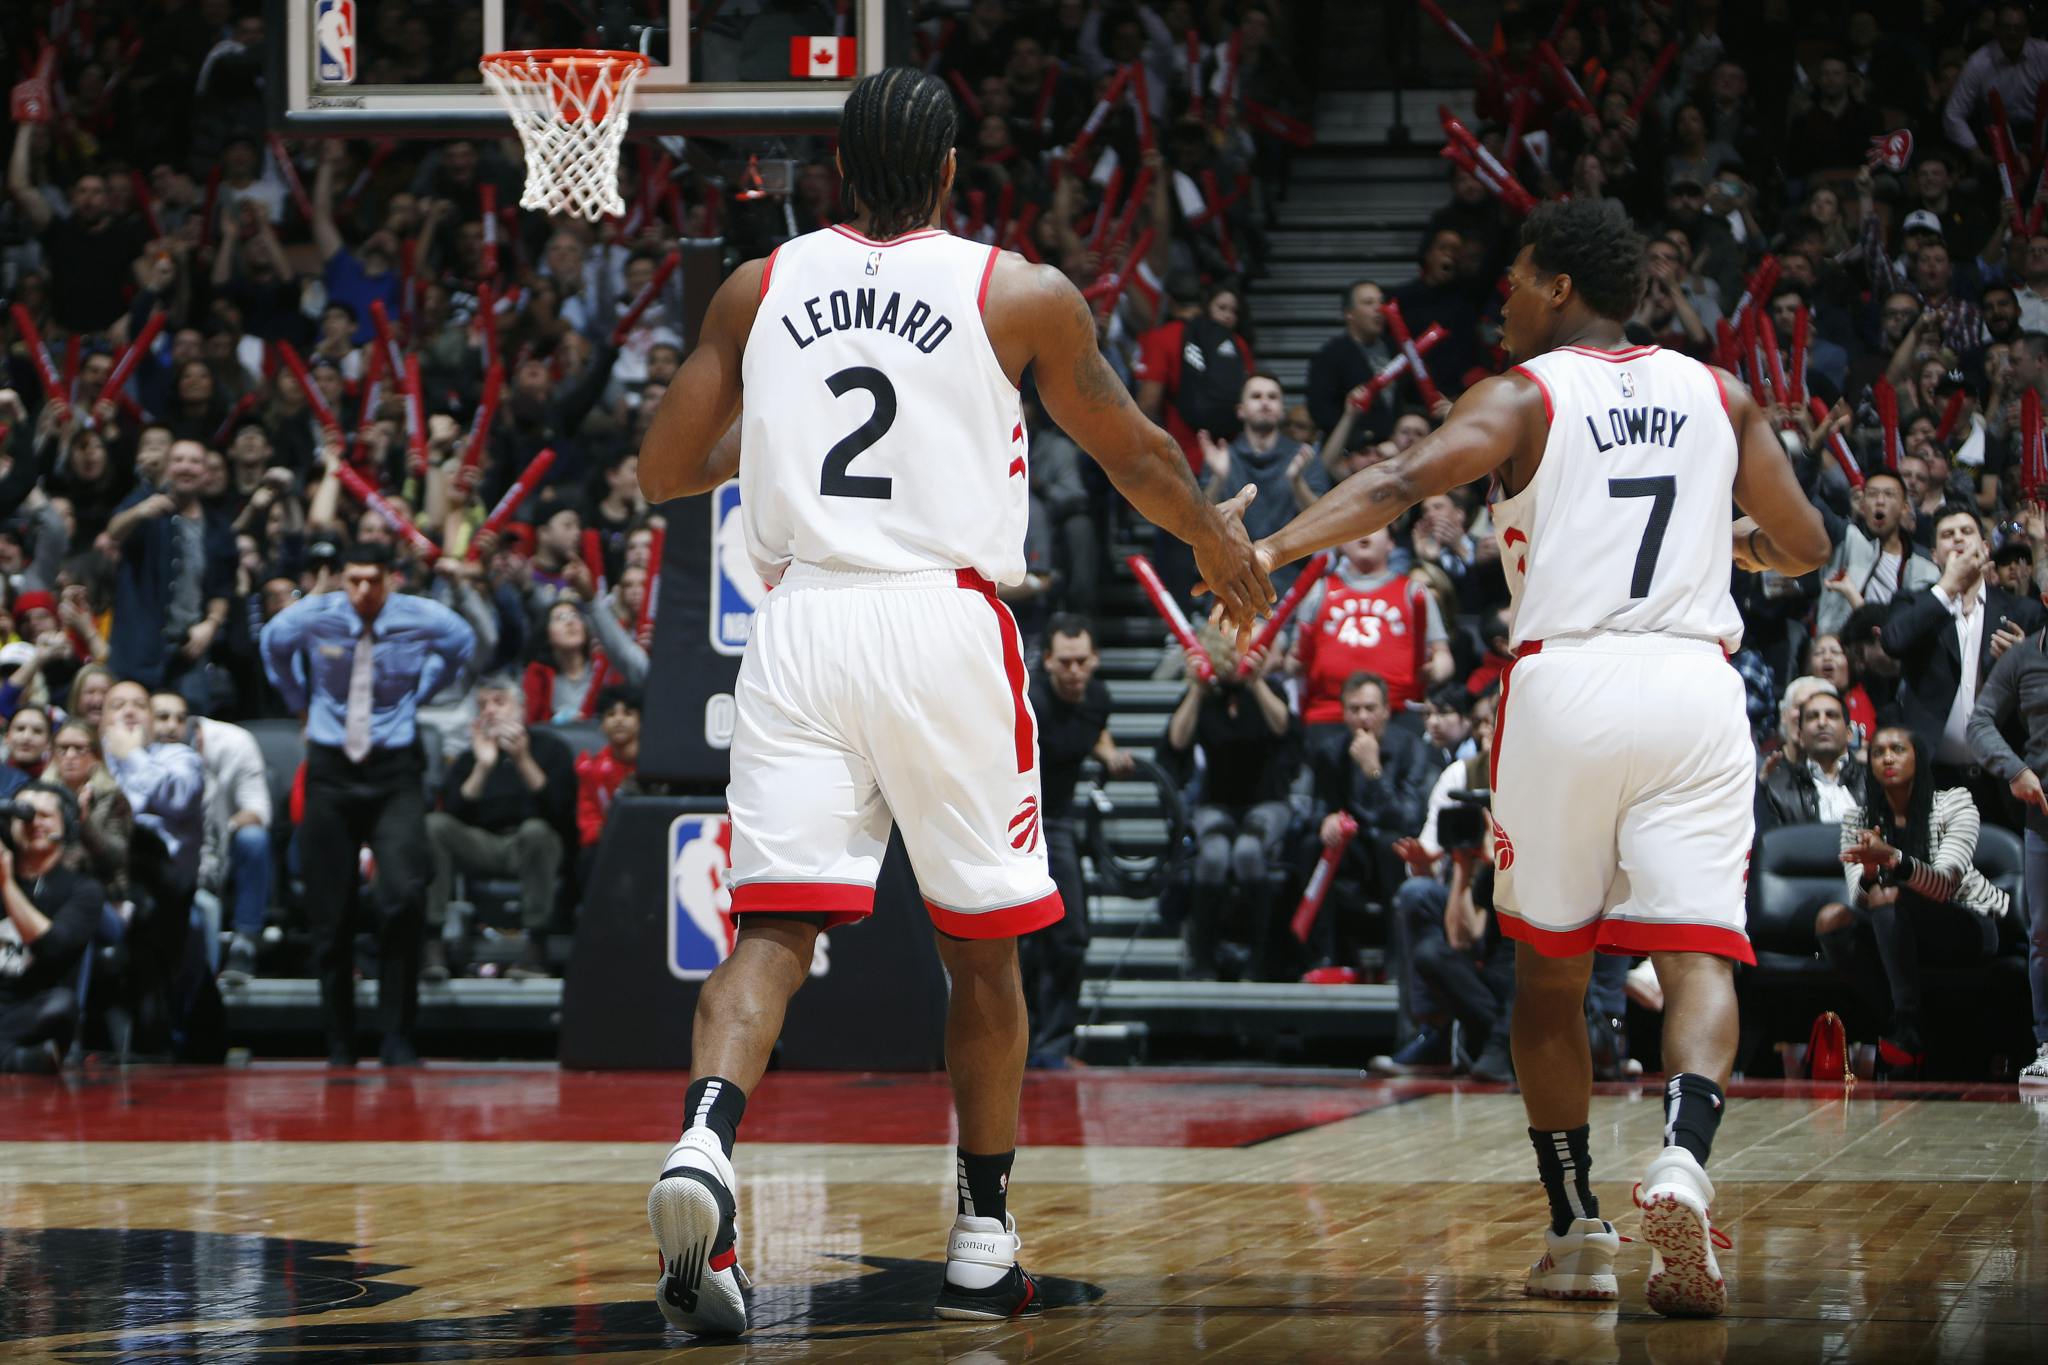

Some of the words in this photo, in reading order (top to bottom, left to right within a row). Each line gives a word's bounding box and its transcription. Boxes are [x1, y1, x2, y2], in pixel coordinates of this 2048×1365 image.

[782, 288, 952, 353] LEONARD
[820, 366, 897, 499] 2
[1586, 406, 1688, 453] LOWRY
[1608, 475, 1677, 599] 7
[1337, 615, 1381, 648] 43
